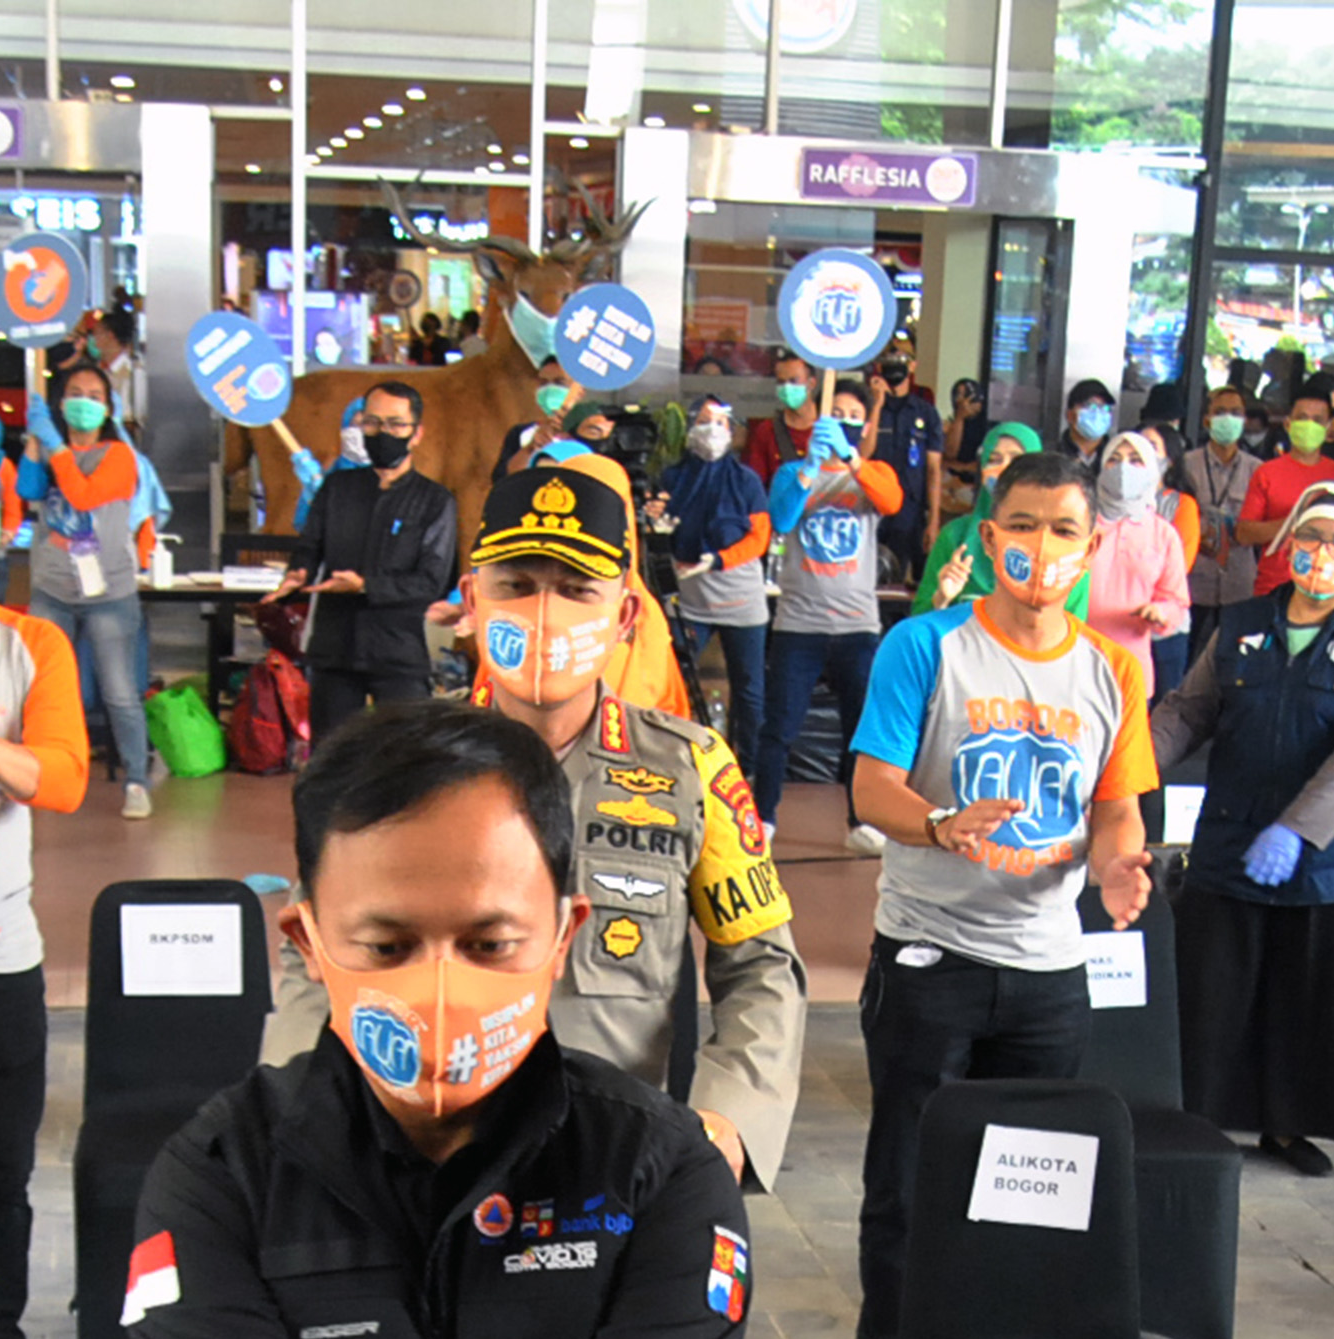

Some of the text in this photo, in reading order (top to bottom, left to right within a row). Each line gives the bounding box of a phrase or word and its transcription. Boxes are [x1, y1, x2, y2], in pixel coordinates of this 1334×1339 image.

[808, 163, 922, 189] RAFFLESIA
[966, 697, 1082, 746] BOGOR
[586, 822, 677, 857] POLRI
[967, 838, 1074, 877] OVID-19
[703, 874, 753, 928] KA
[996, 1153, 1078, 1175] ALIKOTA
[994, 1176, 1059, 1196] BOGOR
[561, 1213, 634, 1236] bank bjb
